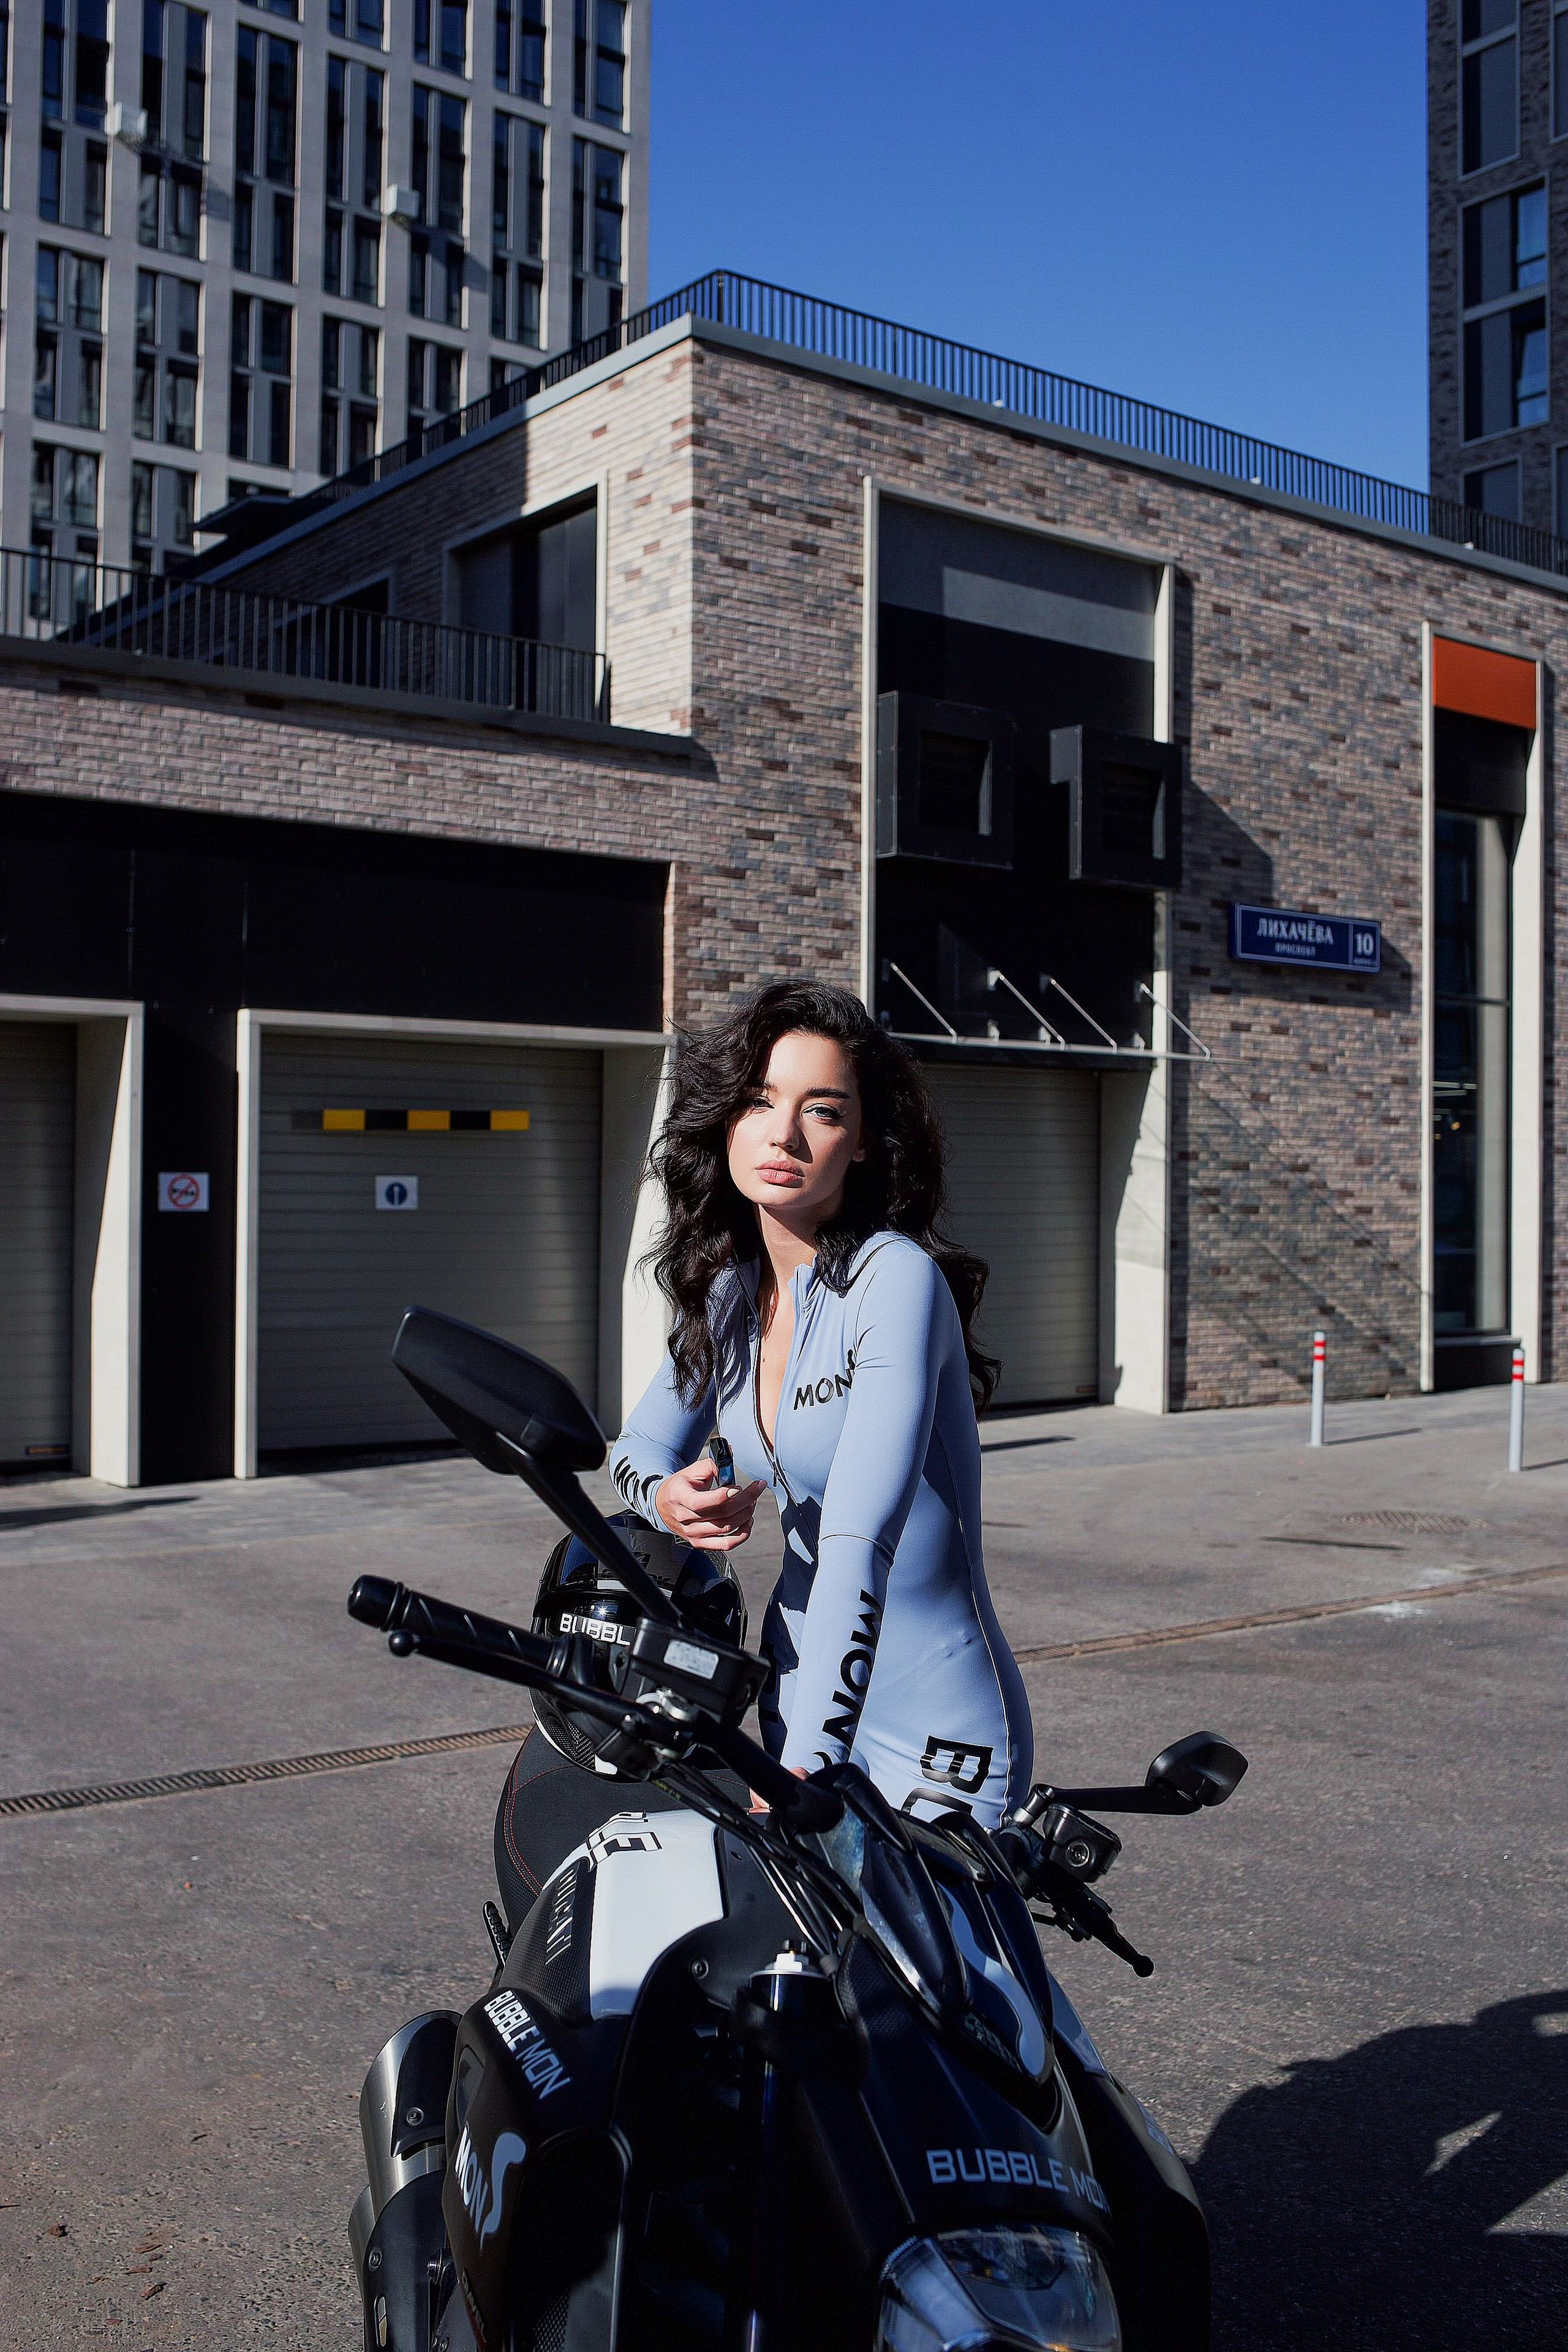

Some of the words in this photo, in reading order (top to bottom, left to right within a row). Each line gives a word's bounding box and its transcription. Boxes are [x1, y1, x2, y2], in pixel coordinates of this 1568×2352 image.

[1257, 918, 1333, 945] ЛИХАЧЁВА
[1355, 933, 1374, 956] 10
[484, 1990, 540, 2053] BUBBLE
[516, 2039, 571, 2100] MON
[926, 2148, 1069, 2193] BUBBLE
